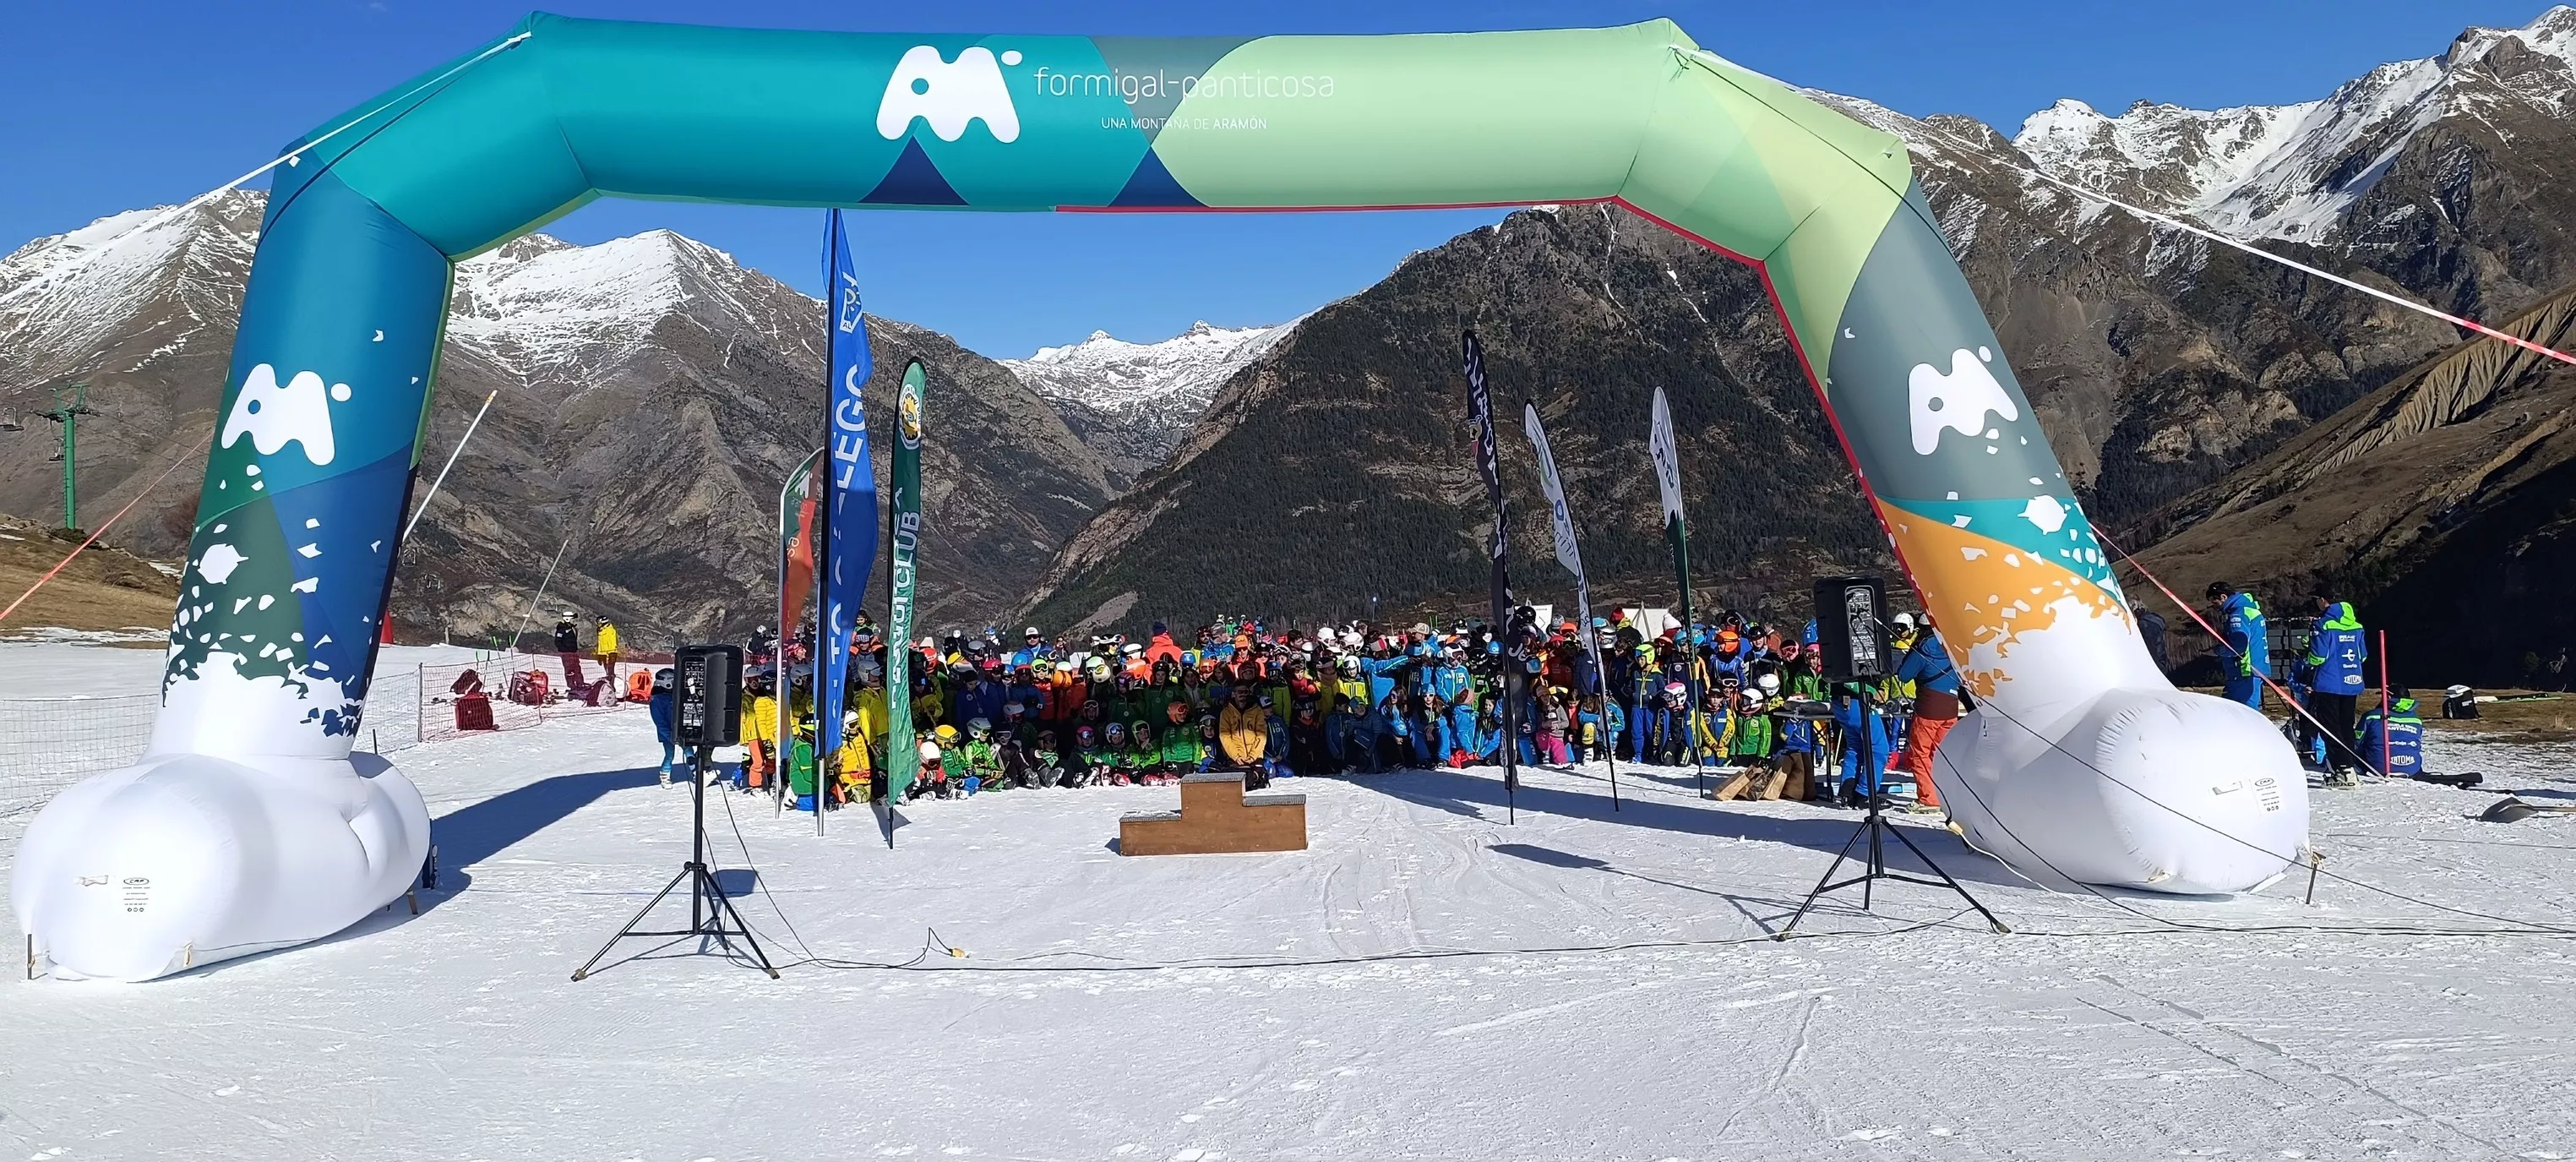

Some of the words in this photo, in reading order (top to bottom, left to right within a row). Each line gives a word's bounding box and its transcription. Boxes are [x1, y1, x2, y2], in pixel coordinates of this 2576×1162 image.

[1033, 66, 1335, 106] formigal-panticosa
[1101, 117, 1128, 129] UNA
[1130, 117, 1190, 129] MONTAÑA
[1195, 118, 1210, 130] DE
[1213, 116, 1267, 130] ARAMÓN
[894, 511, 920, 588] CLUB
